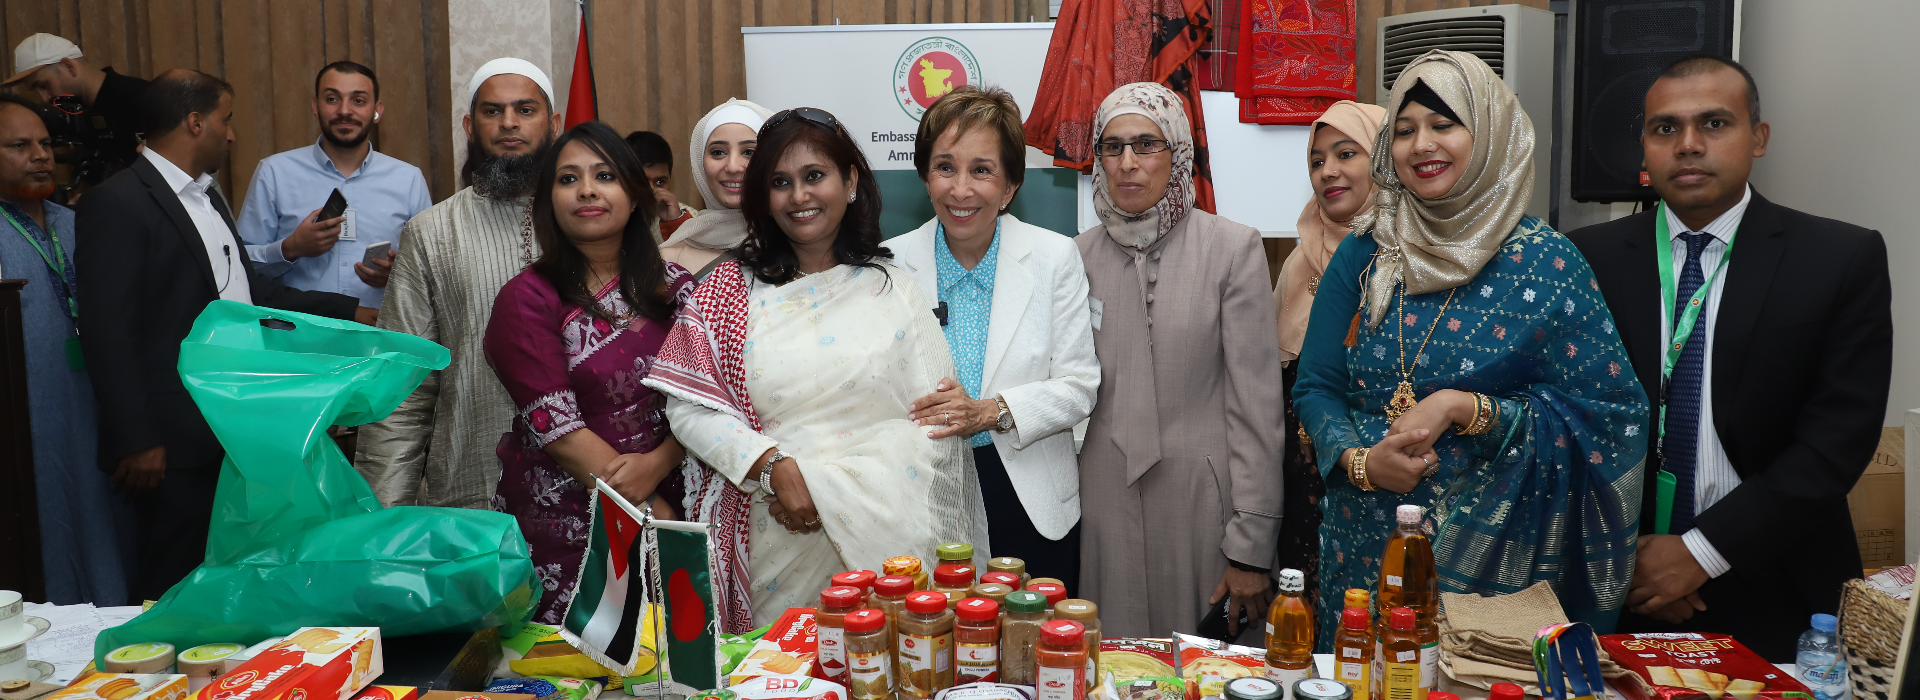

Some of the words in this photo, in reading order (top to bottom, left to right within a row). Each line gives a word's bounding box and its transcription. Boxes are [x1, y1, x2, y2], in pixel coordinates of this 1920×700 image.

[1621, 639, 1734, 653] SWEET
[1662, 650, 1717, 658] TOAST
[765, 677, 799, 690] BD
[1809, 670, 1839, 684] maafi
